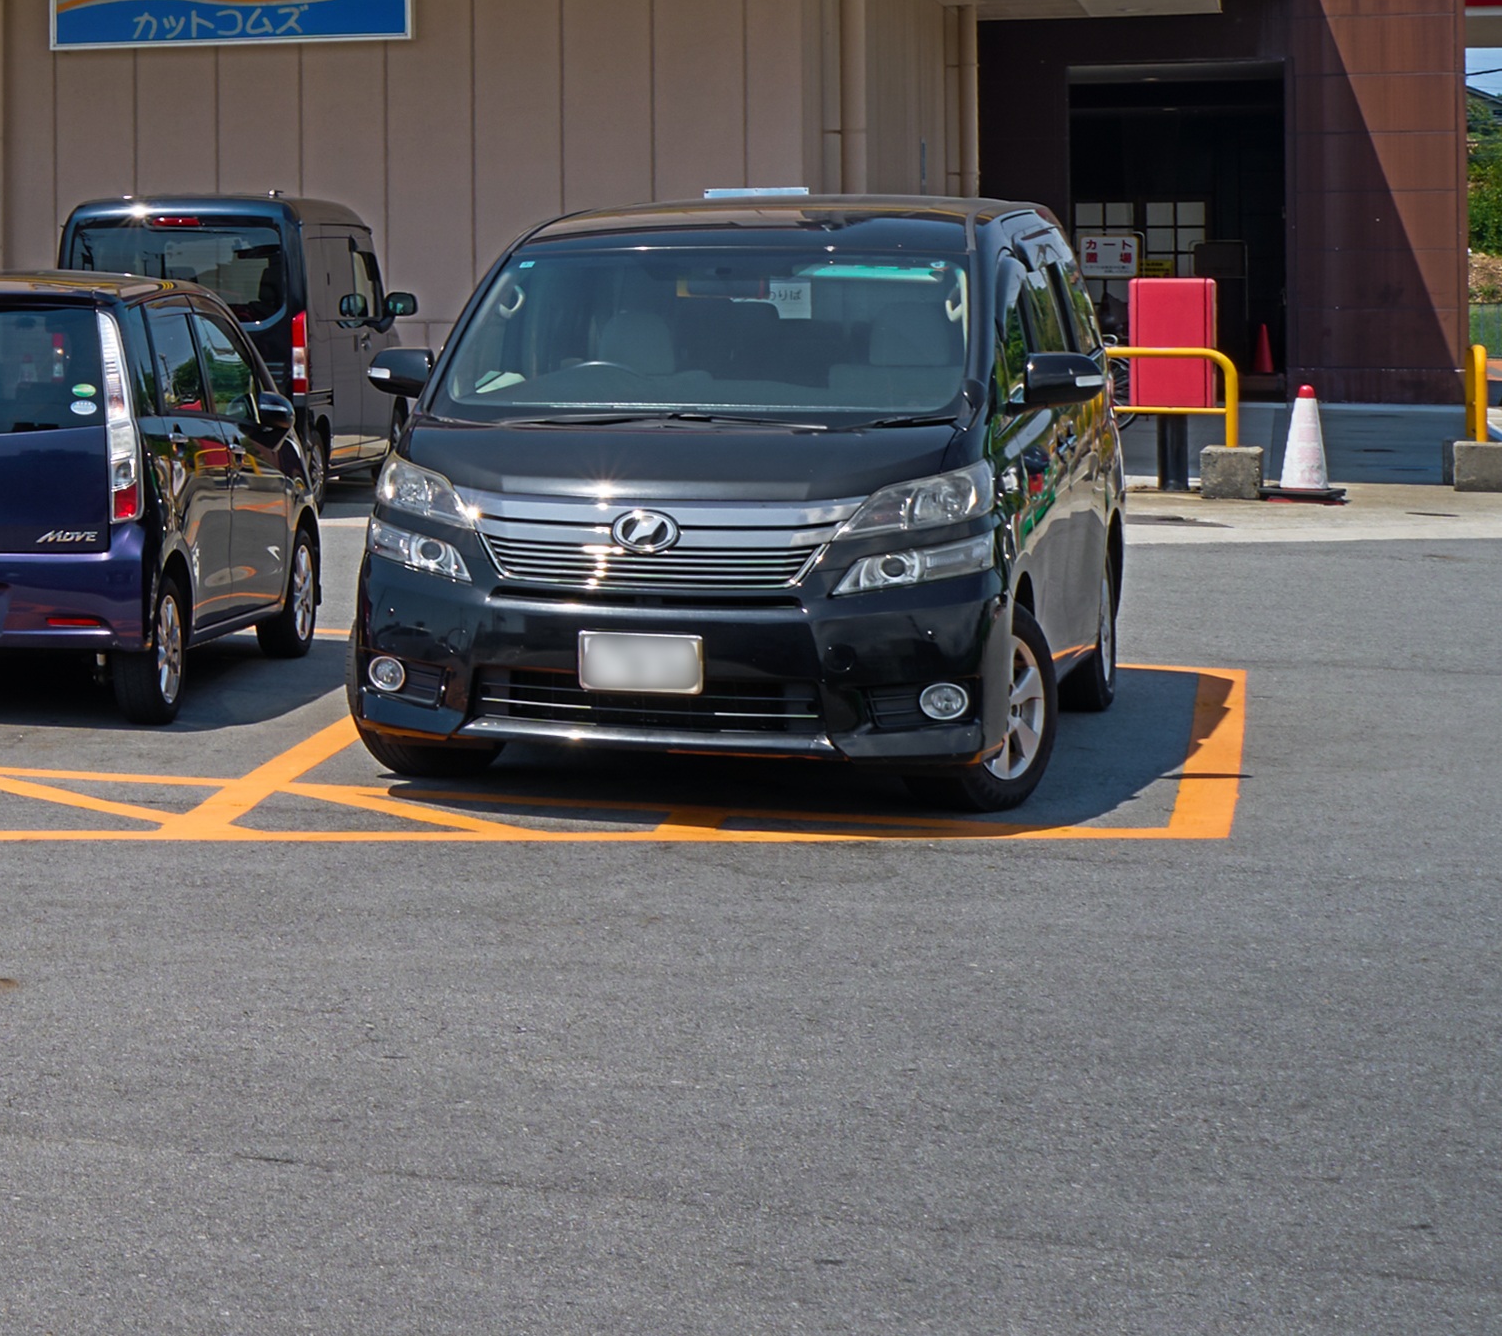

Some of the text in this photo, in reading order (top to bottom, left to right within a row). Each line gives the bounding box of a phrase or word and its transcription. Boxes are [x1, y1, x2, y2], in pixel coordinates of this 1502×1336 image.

[132, 4, 310, 40] カットコムズ
[1085, 239, 1133, 251] カート
[36, 529, 98, 544] MOVE
